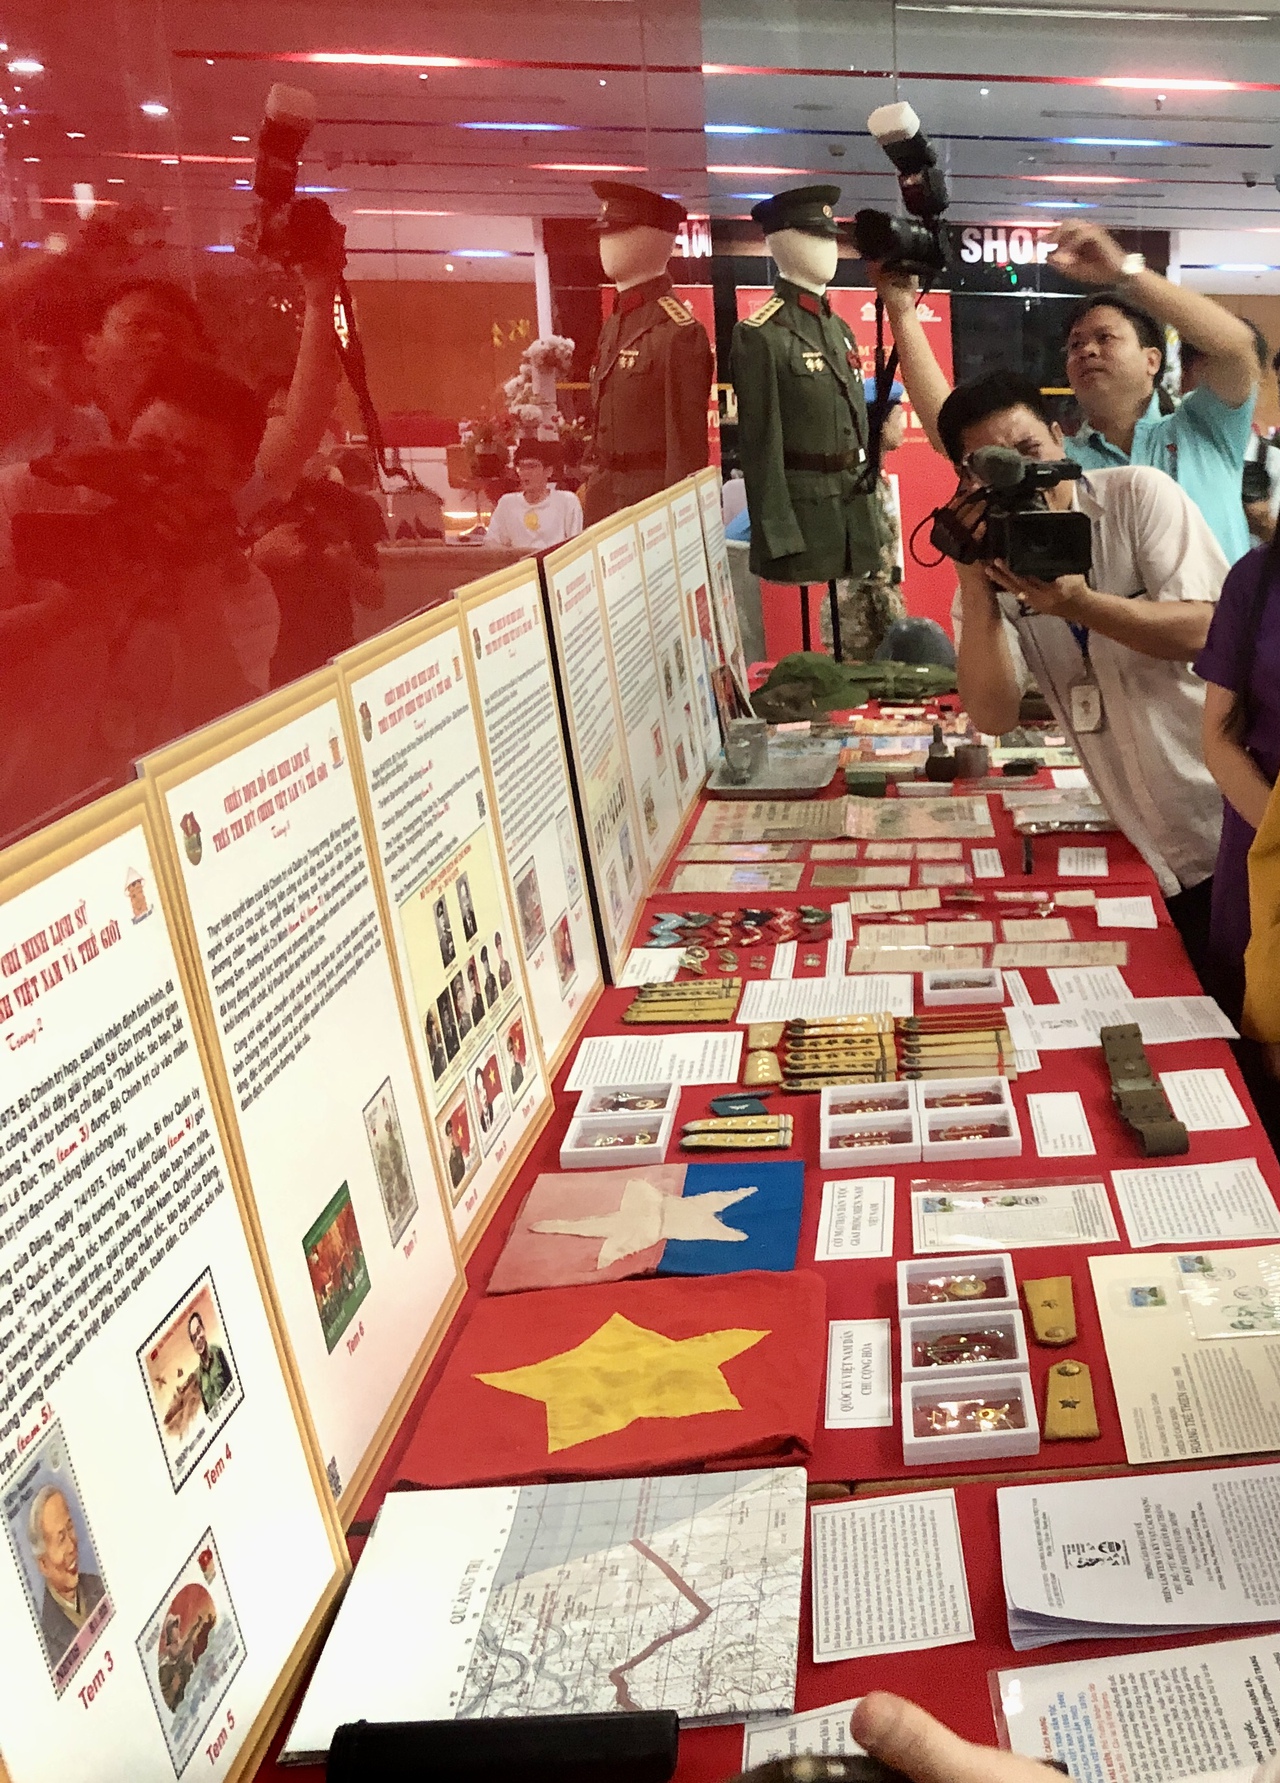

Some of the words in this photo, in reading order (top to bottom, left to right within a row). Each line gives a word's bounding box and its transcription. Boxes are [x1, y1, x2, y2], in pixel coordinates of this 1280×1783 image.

[960, 227, 1058, 264] SHOP
[1, 948, 21, 977] CHÍ
[21, 930, 49, 964] MINH
[49, 914, 74, 946] LỊCH
[74, 901, 87, 929] SỬ
[13, 976, 39, 1006] VIỆT
[40, 961, 63, 991] NAM
[62, 953, 78, 973] VÀ
[78, 933, 99, 964] THẾ
[100, 920, 121, 949] GIỚI
[0, 1159, 22, 1186] háng
[204, 1458, 225, 1489] Tem
[225, 1443, 232, 1459] 4
[78, 1669, 105, 1709] Tem
[104, 1650, 113, 1672] 3
[206, 1728, 227, 1765] Tem
[227, 1710, 235, 1730] 5
